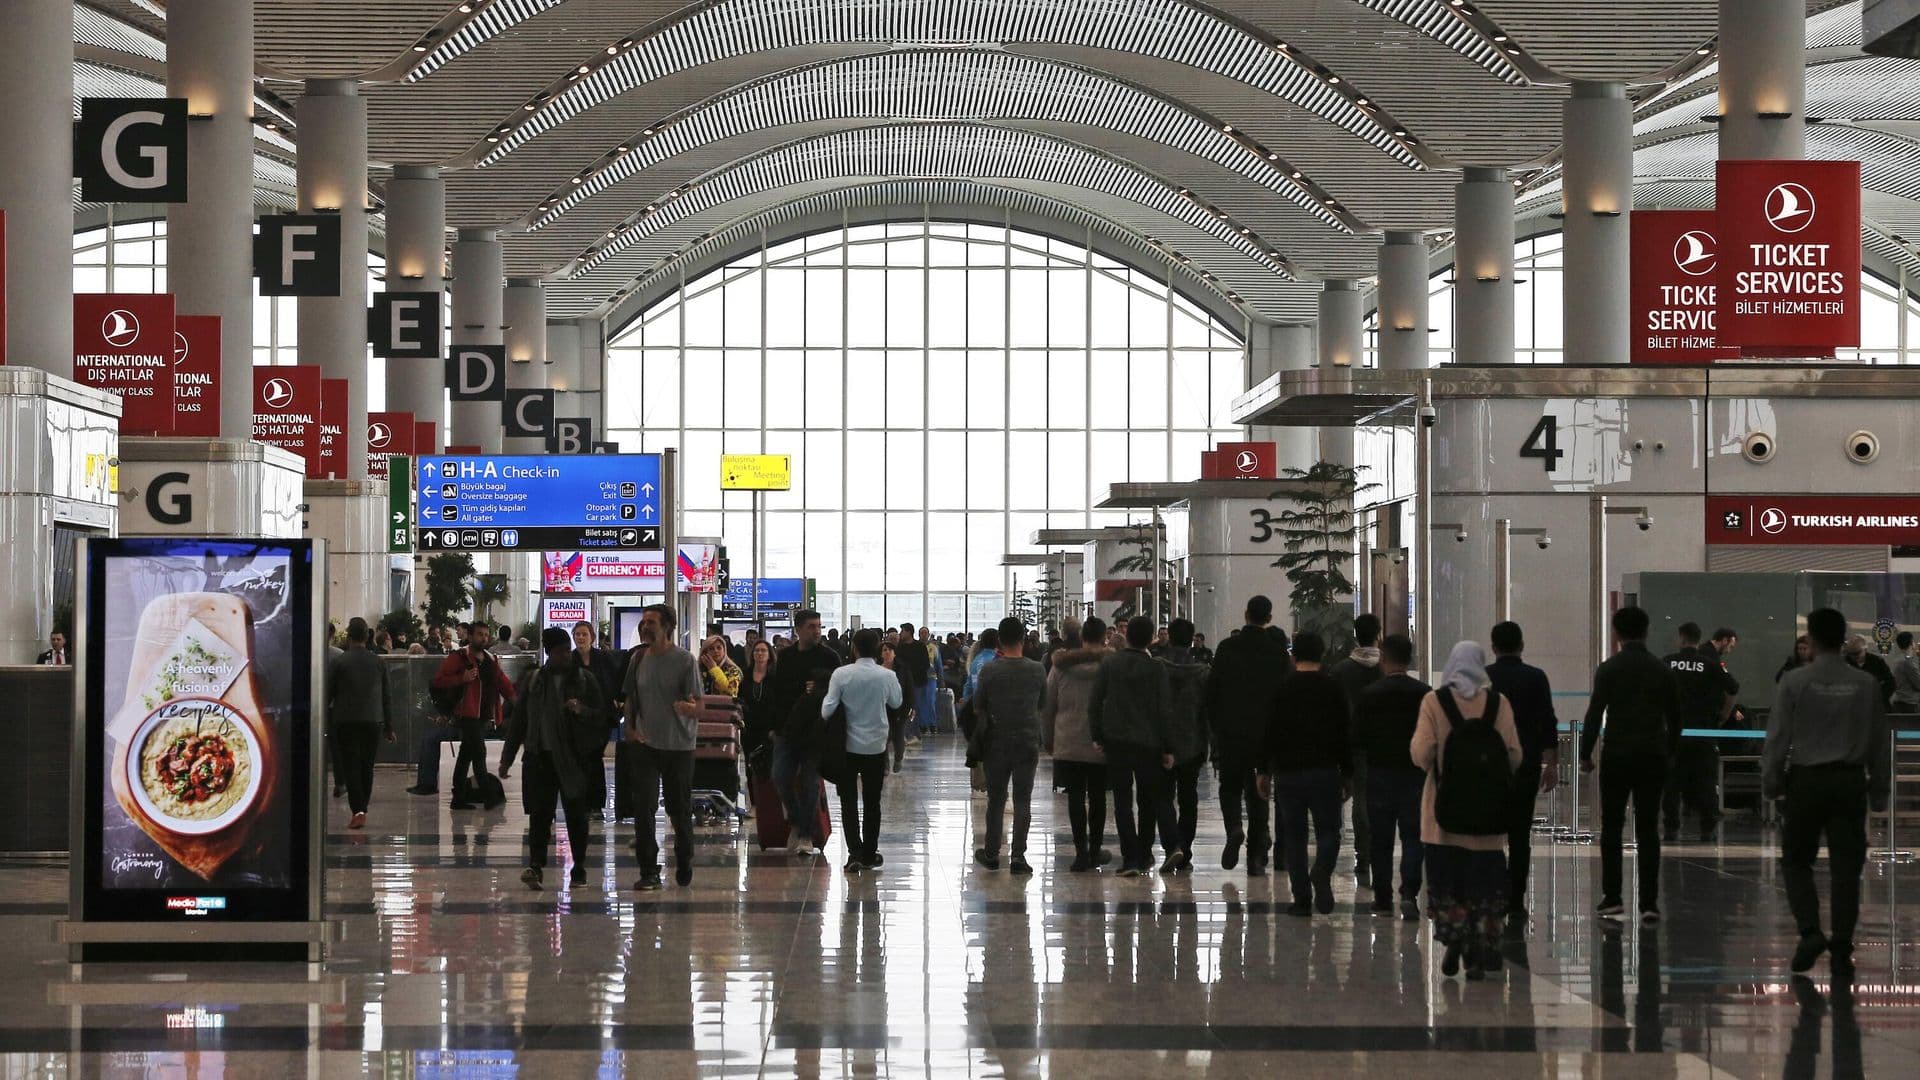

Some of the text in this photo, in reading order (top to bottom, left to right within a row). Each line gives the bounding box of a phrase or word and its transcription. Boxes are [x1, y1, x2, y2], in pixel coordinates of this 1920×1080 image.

[101, 111, 168, 189] G
[282, 226, 317, 285] F
[1750, 244, 1830, 266] TICKET
[1735, 272, 1844, 294] SERVICES
[1661, 285, 1716, 306] TICKE
[1735, 299, 1844, 314] BİLET HİZMETLERİ
[391, 301, 421, 349] E
[1648, 310, 1716, 331] SERVIC
[1648, 335, 1716, 349] BİLET HİZME
[76, 355, 166, 367] INTERNATIONAL
[88, 369, 153, 382] DIŞ HATLAR
[459, 352, 495, 394] D
[128, 388, 154, 396] CLASS
[175, 387, 201, 398] TLAR
[252, 414, 314, 424] TERNATIONAL
[516, 394, 544, 432] C
[252, 425, 305, 436] DIŞ HATLAR
[559, 423, 581, 454] B
[1520, 415, 1563, 472] 4
[461, 461, 560, 478] H-A Check-in
[784, 457, 788, 472] 1
[461, 483, 507, 492] Büyük bagaj
[600, 482, 617, 491] Çıkış
[145, 472, 192, 525] G
[494, 493, 528, 502] baggage
[461, 504, 526, 513] Tüm gidiş kapıları
[586, 503, 617, 512] Otopark
[472, 514, 493, 523] gates
[600, 513, 617, 522] park
[1792, 515, 1919, 527] TURKISH AIRLINES
[1250, 508, 1272, 543] 3
[585, 529, 618, 538] Bilet satış
[579, 538, 618, 546] Ticket sales
[589, 565, 640, 575] CURRENCY
[549, 602, 585, 610] PARANIZI
[166, 663, 234, 677] A heavenly
[172, 681, 226, 692] fusion of
[159, 704, 240, 738] recipes
